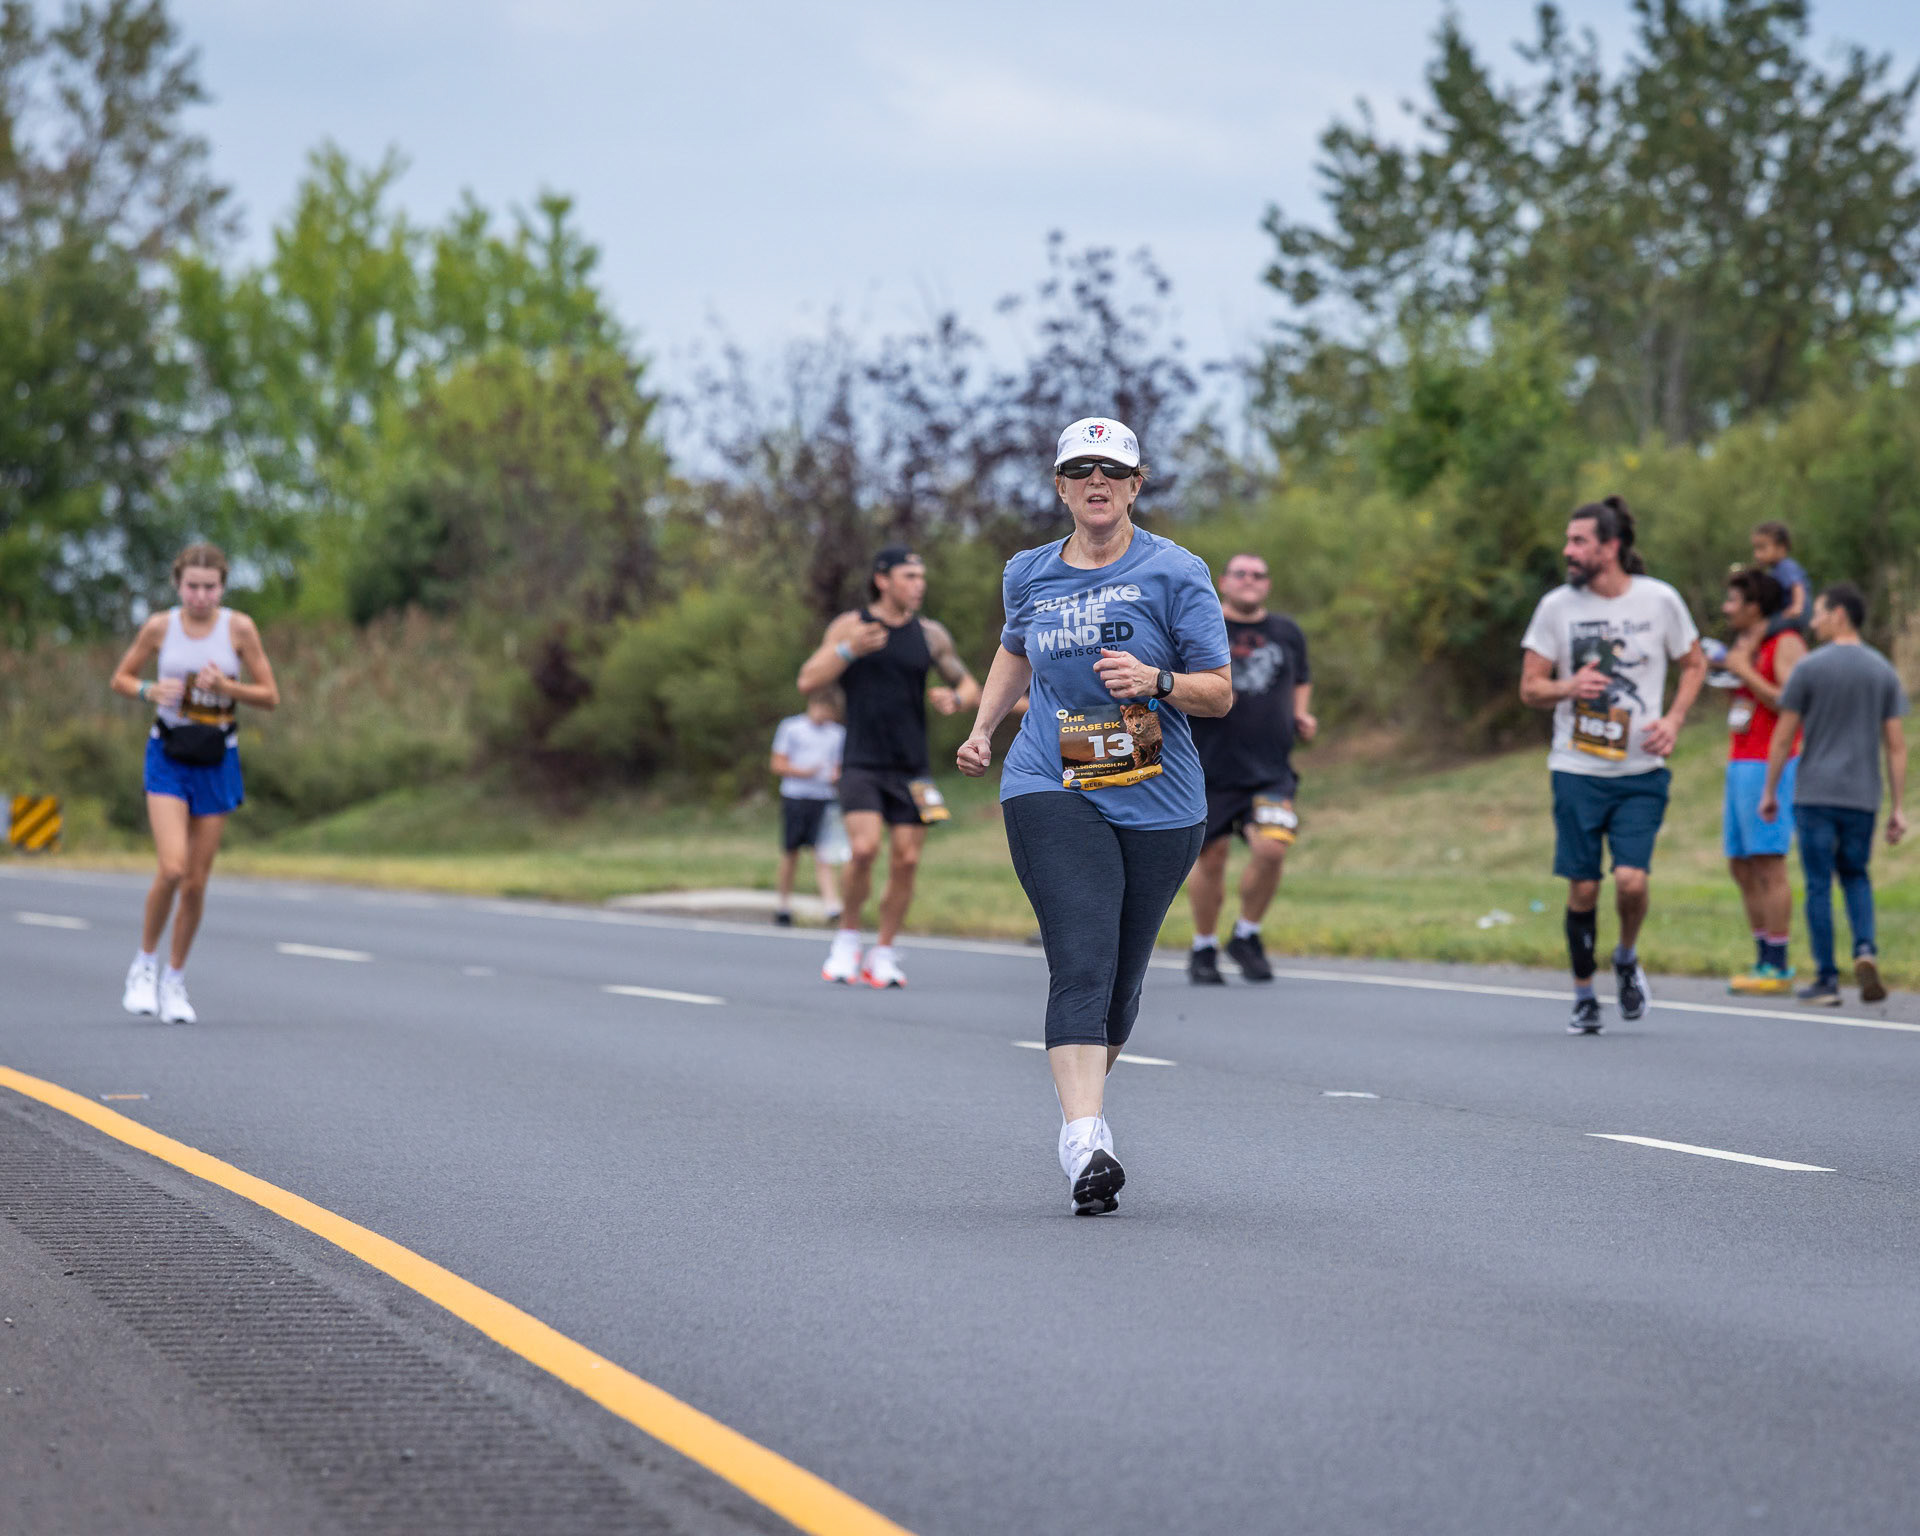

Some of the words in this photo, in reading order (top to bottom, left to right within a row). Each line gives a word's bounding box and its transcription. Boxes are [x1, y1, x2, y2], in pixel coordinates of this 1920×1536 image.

[1060, 603, 1106, 628] THE
[1037, 621, 1134, 653] WINDED
[1075, 648, 1084, 657] IS
[1061, 723, 1102, 733] CHASE
[1103, 721, 1121, 730] 5K
[1088, 732, 1135, 758] 13
[1139, 770, 1158, 780] CCK
